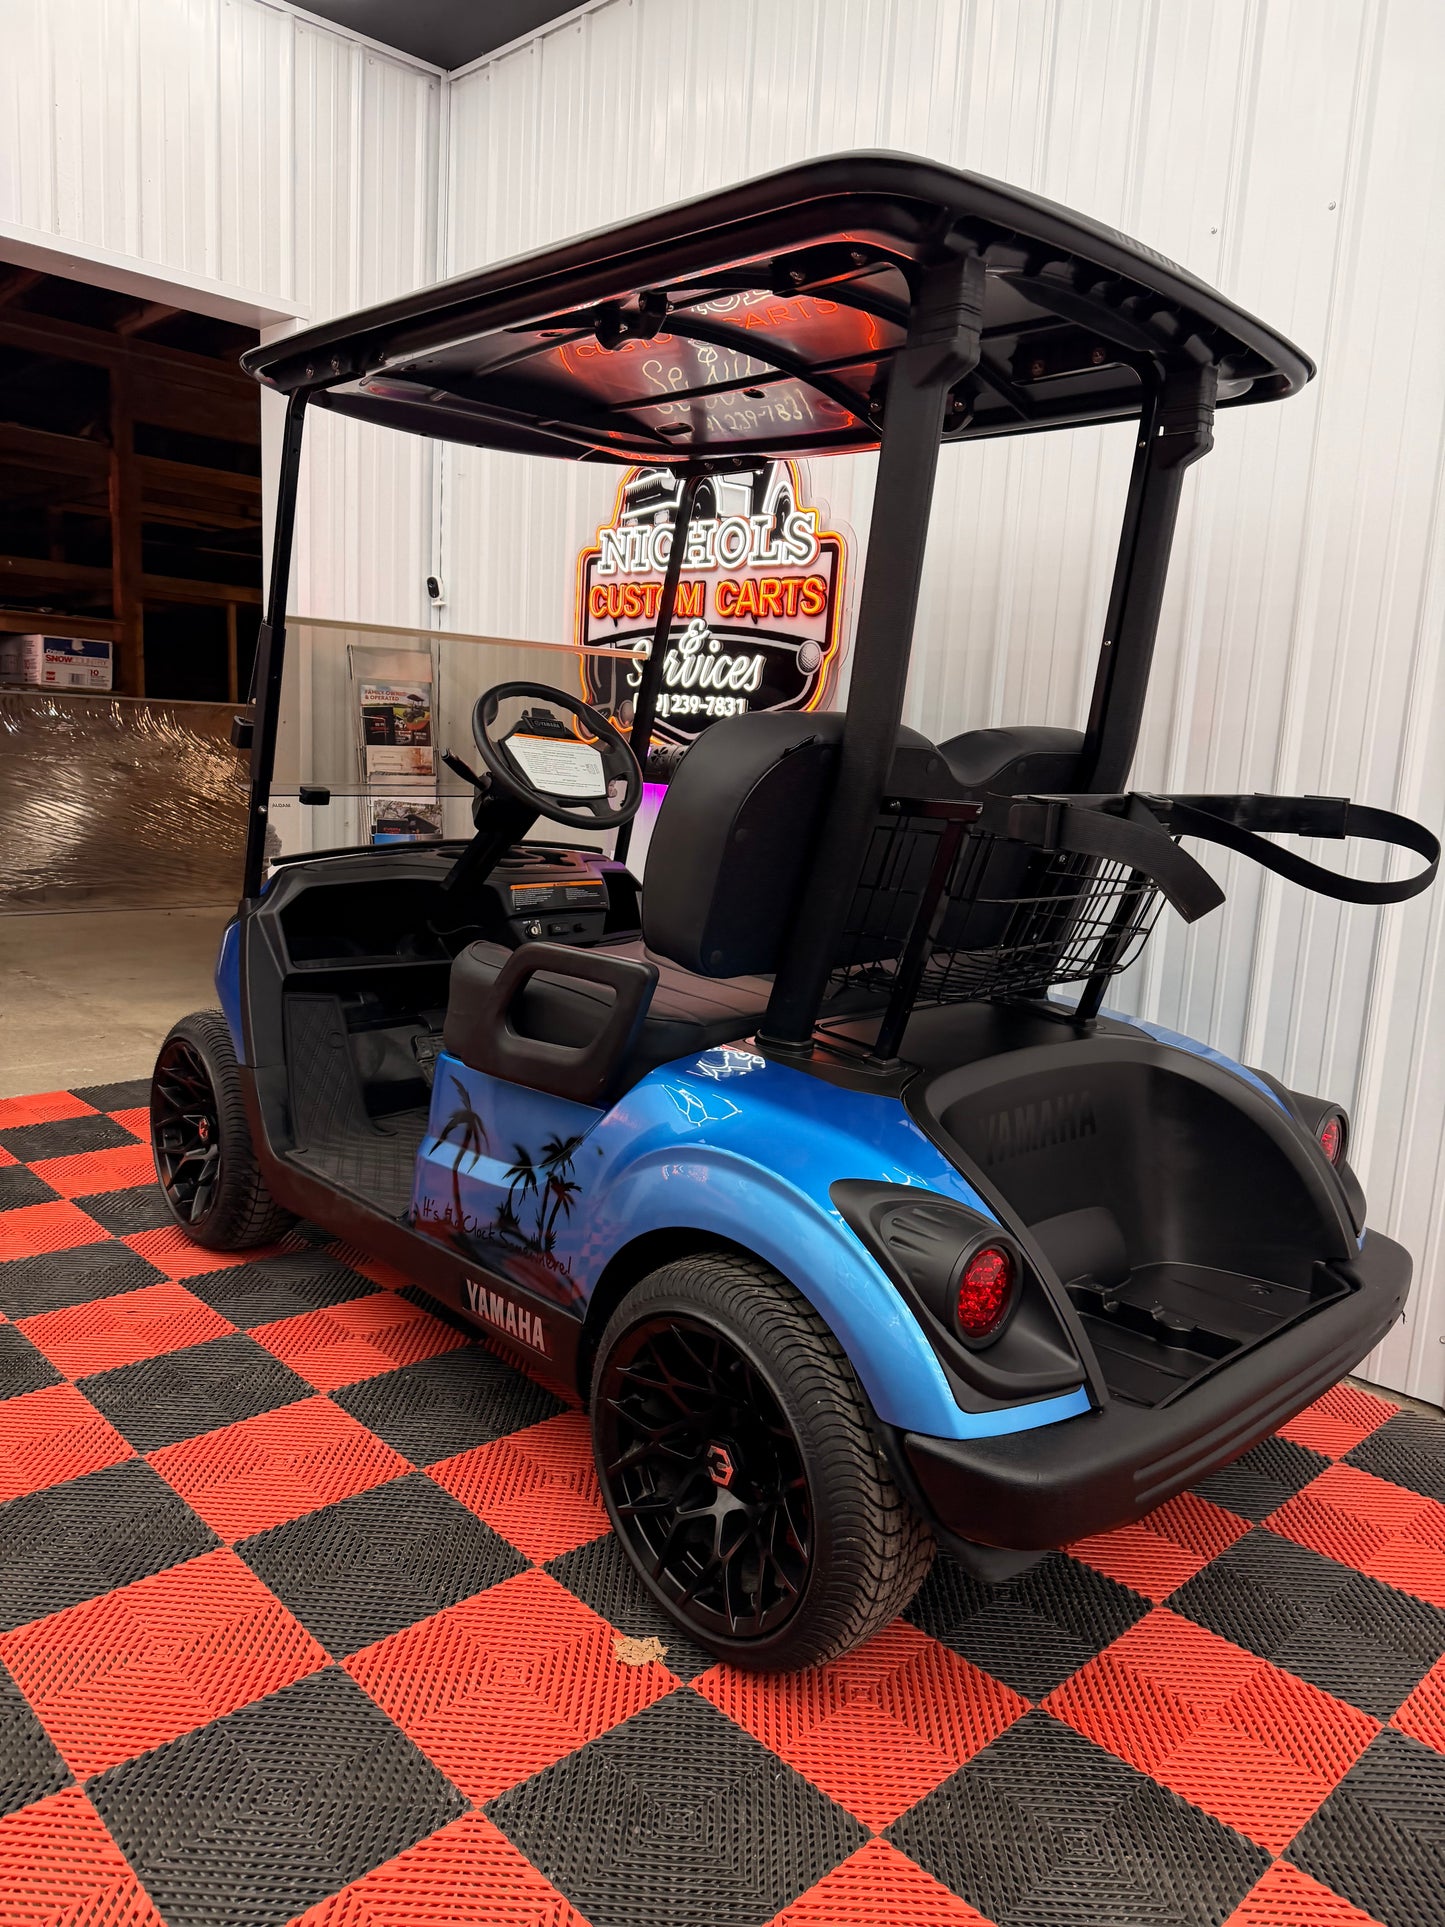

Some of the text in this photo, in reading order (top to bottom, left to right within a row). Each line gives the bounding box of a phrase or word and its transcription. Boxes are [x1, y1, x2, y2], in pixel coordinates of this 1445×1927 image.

[598, 511, 820, 575] NICHOLS
[589, 577, 827, 618] CUSTM CARTS
[45, 654, 73, 663] SNOW
[678, 618, 710, 654] &
[626, 638, 766, 691] Srvices
[671, 694, 746, 716] 239-7831
[979, 1090, 1096, 1165] YAMAHA
[466, 1279, 545, 1352] YAMAHA
